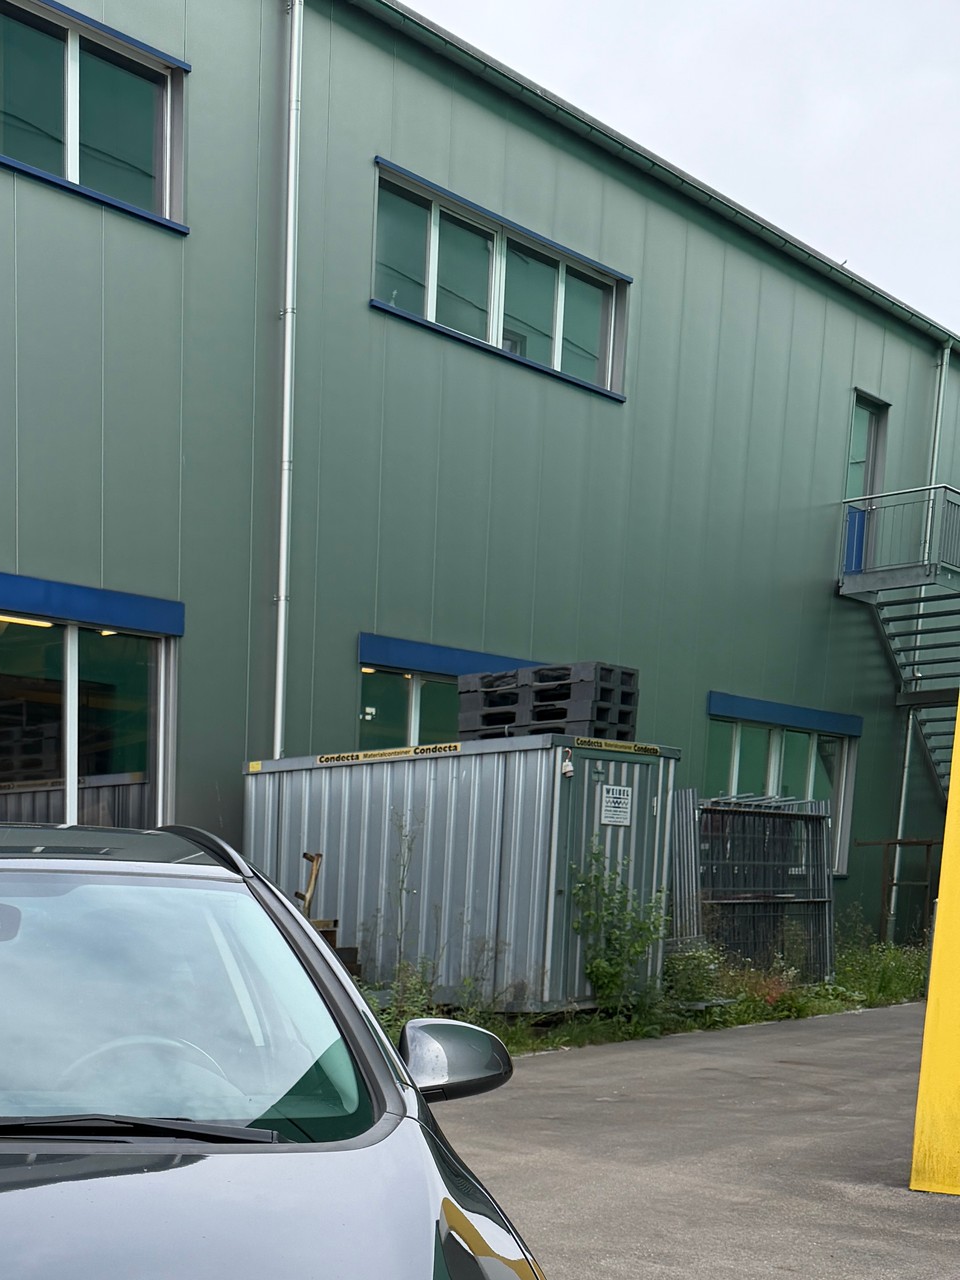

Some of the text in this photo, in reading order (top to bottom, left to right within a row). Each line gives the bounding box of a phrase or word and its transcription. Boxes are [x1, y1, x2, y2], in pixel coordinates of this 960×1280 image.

[318, 744, 458, 764] Condecta Materialcontainer Condecta
[576, 738, 603, 748] Condecta
[633, 744, 659, 755] Condecta
